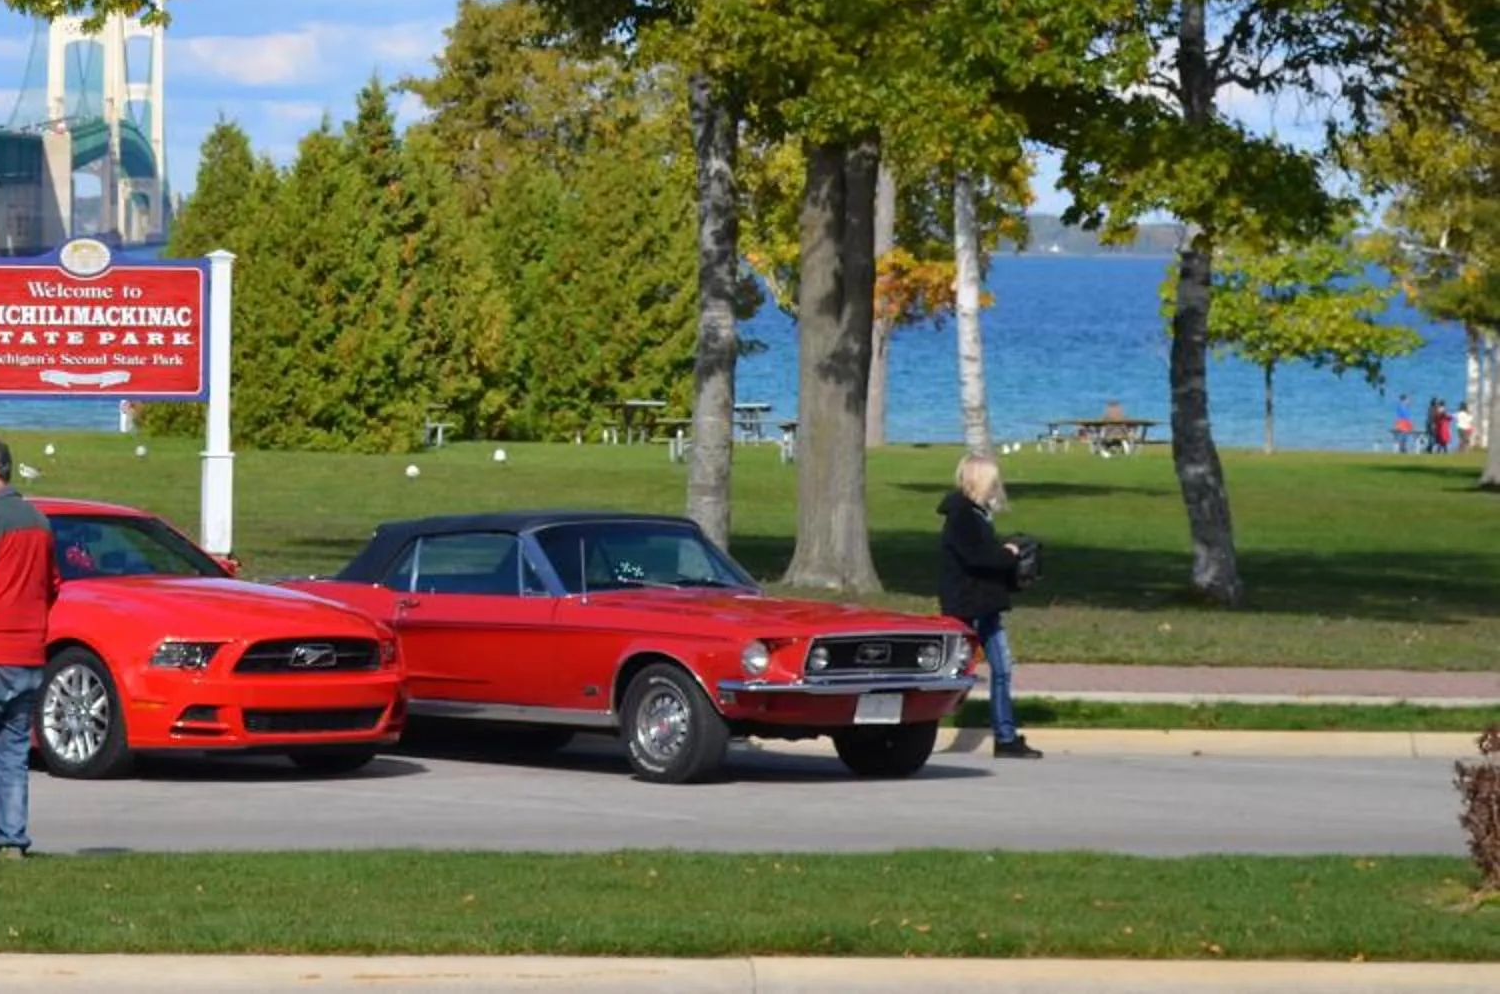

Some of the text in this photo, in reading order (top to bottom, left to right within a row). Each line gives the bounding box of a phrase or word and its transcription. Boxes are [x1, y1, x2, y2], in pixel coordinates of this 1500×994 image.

[28, 281, 143, 299] Welcome to
[99, 331, 194, 346] PARK
[60, 353, 108, 366] Second
[113, 353, 148, 366] State
[153, 354, 184, 366] Park
